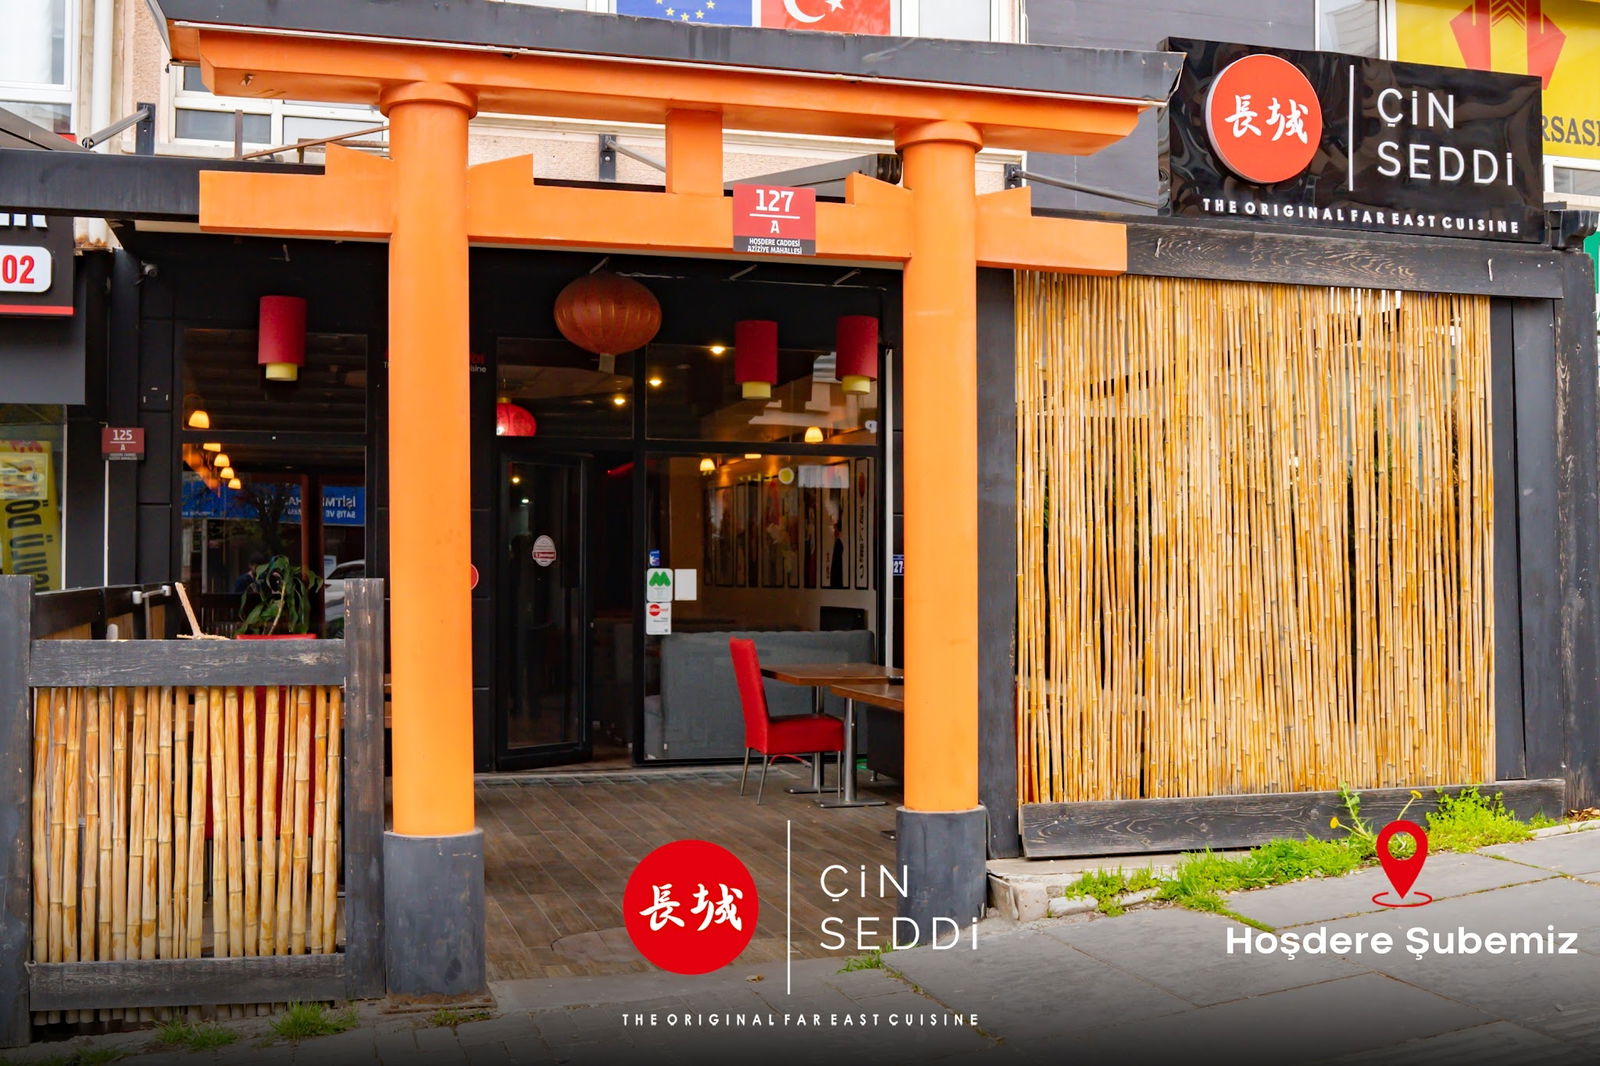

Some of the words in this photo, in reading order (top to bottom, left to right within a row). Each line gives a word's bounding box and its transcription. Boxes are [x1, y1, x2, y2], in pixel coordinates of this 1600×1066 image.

[1224, 94, 1309, 144] 長城
[755, 189, 795, 212] 127
[770, 220, 780, 234] A
[1202, 198, 1237, 213] THE
[1244, 201, 1345, 221] ORIGINAL
[1350, 209, 1385, 224] FAR
[1391, 212, 1436, 228] EAST
[1441, 216, 1519, 234] CUISINE
[112, 429, 133, 441] 125
